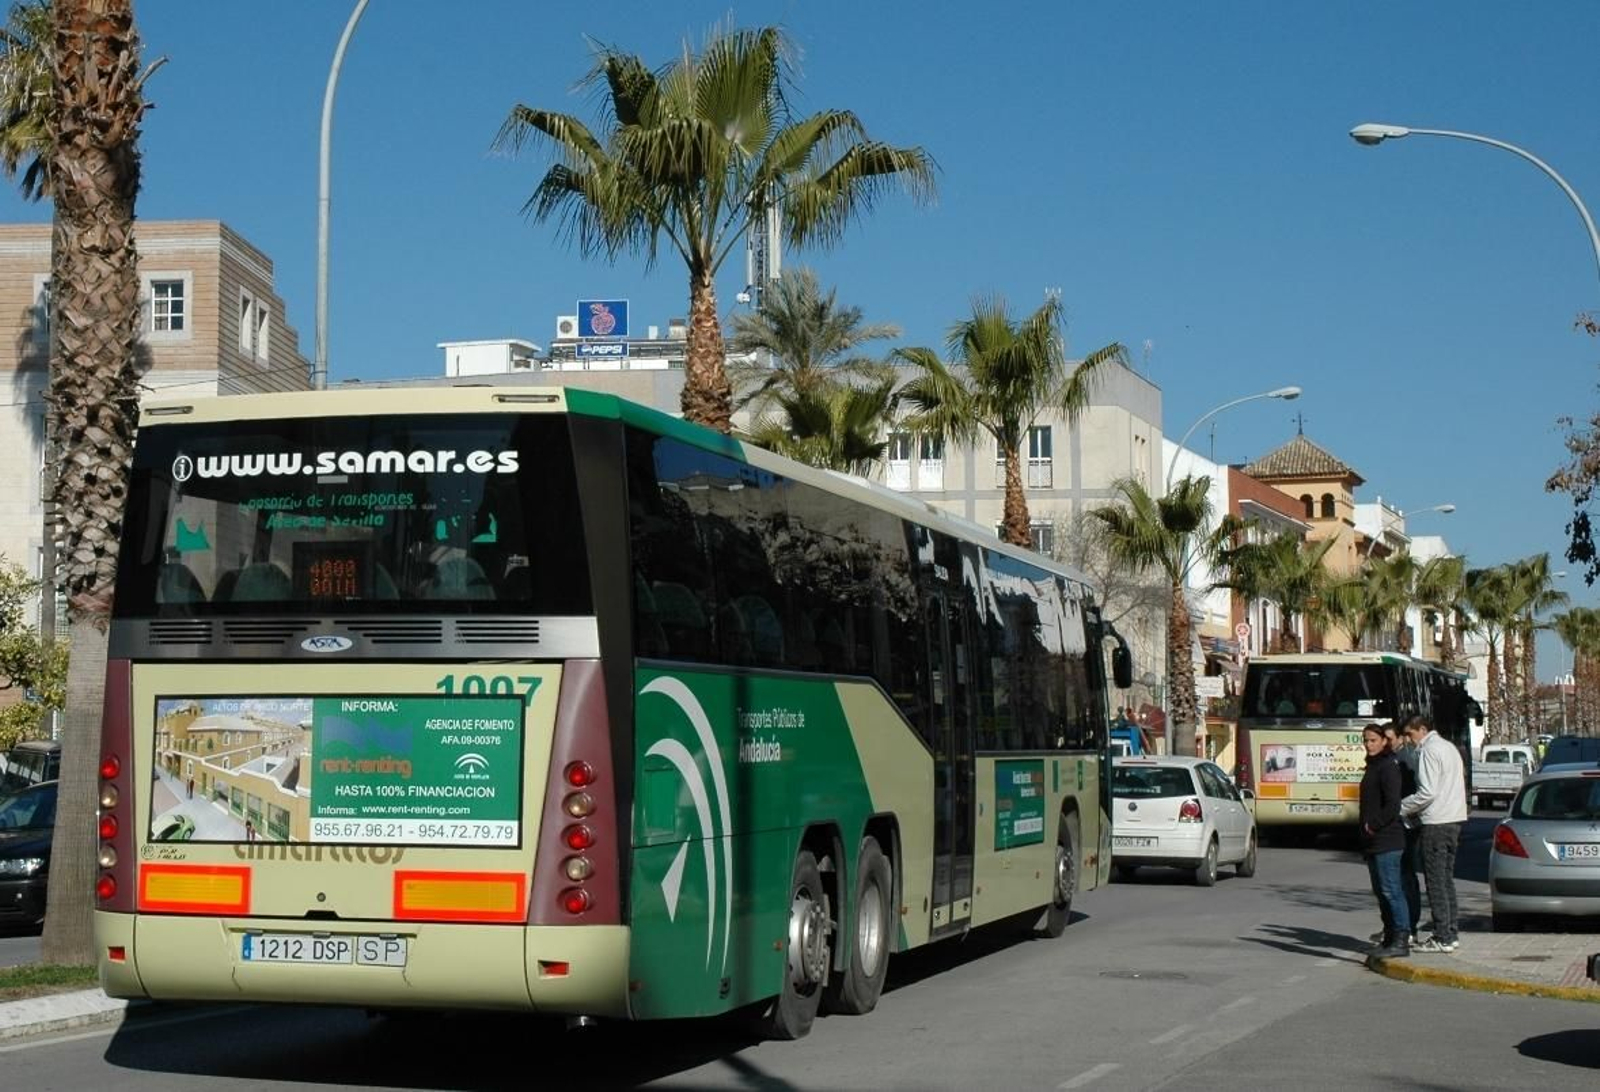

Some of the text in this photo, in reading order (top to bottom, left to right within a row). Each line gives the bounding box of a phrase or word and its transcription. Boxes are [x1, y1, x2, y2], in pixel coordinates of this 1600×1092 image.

[592, 345, 623, 354] PEPSI
[197, 450, 519, 478] www.samar.es
[341, 700, 399, 713] INFORMA:
[425, 719, 515, 731] AGENCIA DE FOMENTO
[737, 707, 772, 733] Transportes
[739, 733, 781, 763] Andalucía
[335, 785, 495, 798] HASTA 100% FINANCIACION
[318, 804, 471, 816] Informa: www.rent-renting.com
[314, 822, 404, 838] 955.67.96.21
[418, 824, 514, 840] 954.72.79.79
[1568, 845, 1598, 856] 9459
[259, 938, 349, 961] 1212 DSP
